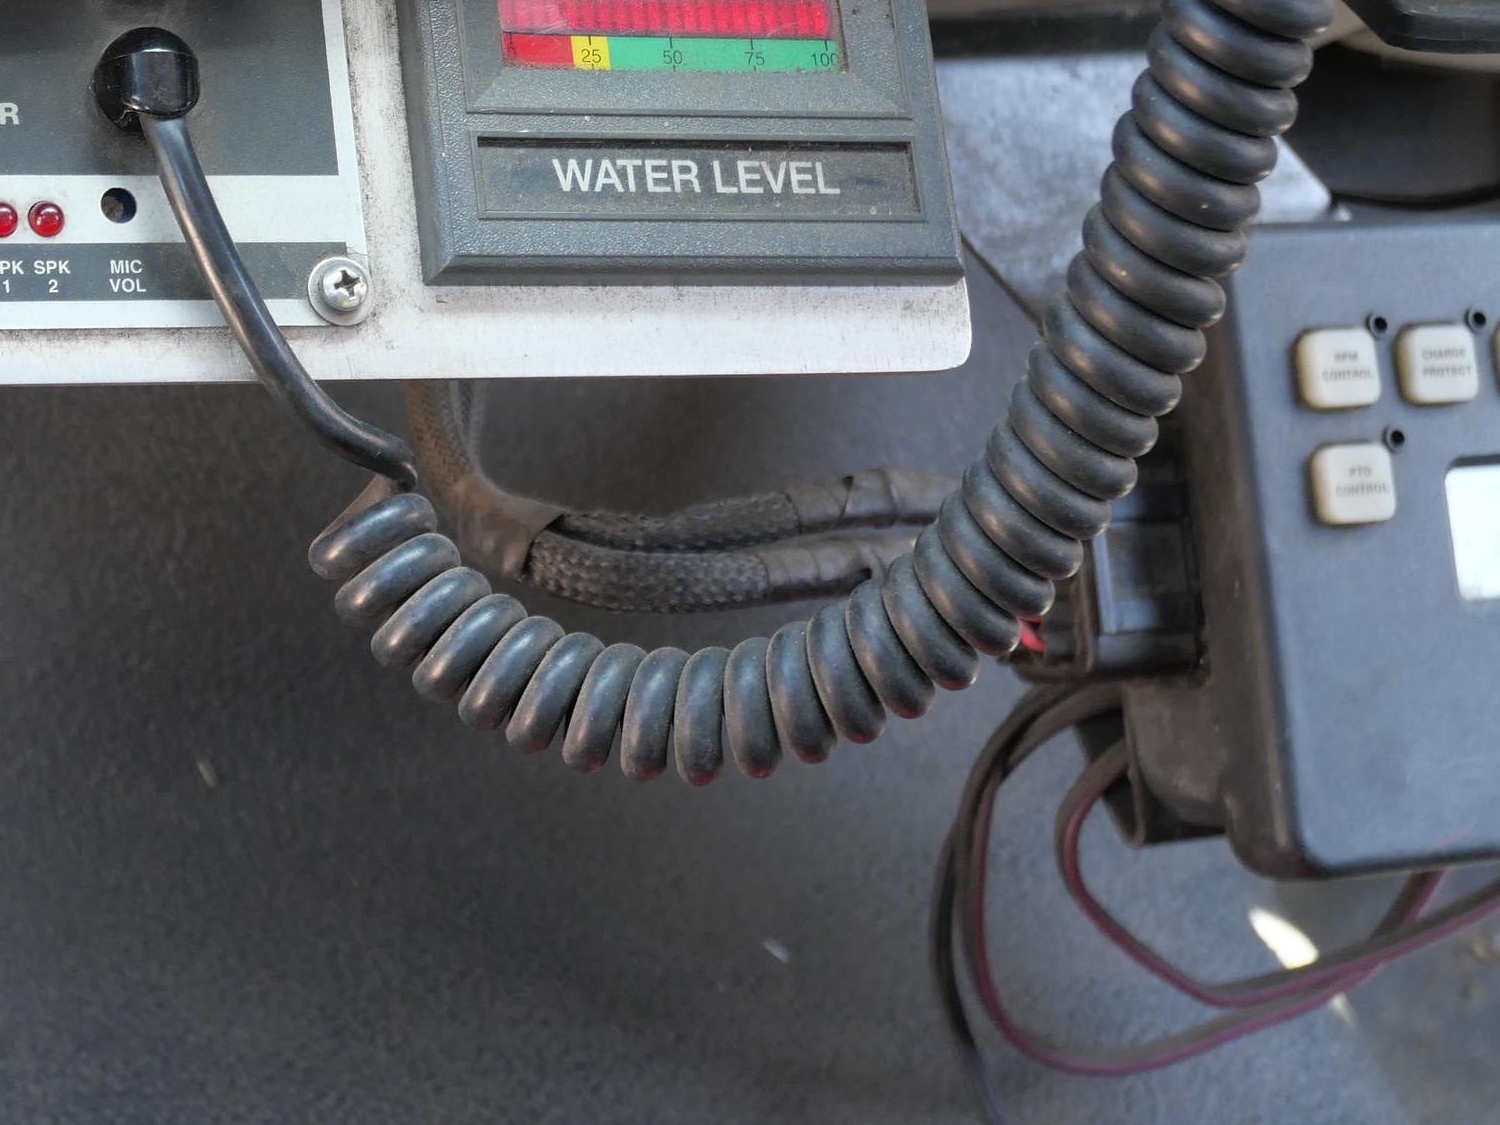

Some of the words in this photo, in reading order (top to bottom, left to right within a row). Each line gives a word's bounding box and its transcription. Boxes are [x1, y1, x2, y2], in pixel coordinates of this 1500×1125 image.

[581, 48, 602, 63] 25
[662, 49, 683, 66] 50
[744, 51, 765, 66] 75
[811, 52, 838, 68] 100
[552, 158, 701, 194] WATER
[713, 161, 841, 195] LEVEL
[33, 260, 71, 275] SPK
[110, 259, 143, 274] MIC
[2, 279, 11, 294] 1
[48, 279, 59, 293] 2
[109, 278, 147, 293] VOL
[1422, 348, 1467, 359] CHARGE
[1322, 369, 1374, 381] CONTROL
[1422, 366, 1473, 377] PROTECT
[1348, 467, 1372, 477] PTO
[1336, 483, 1389, 496] CONTROL
